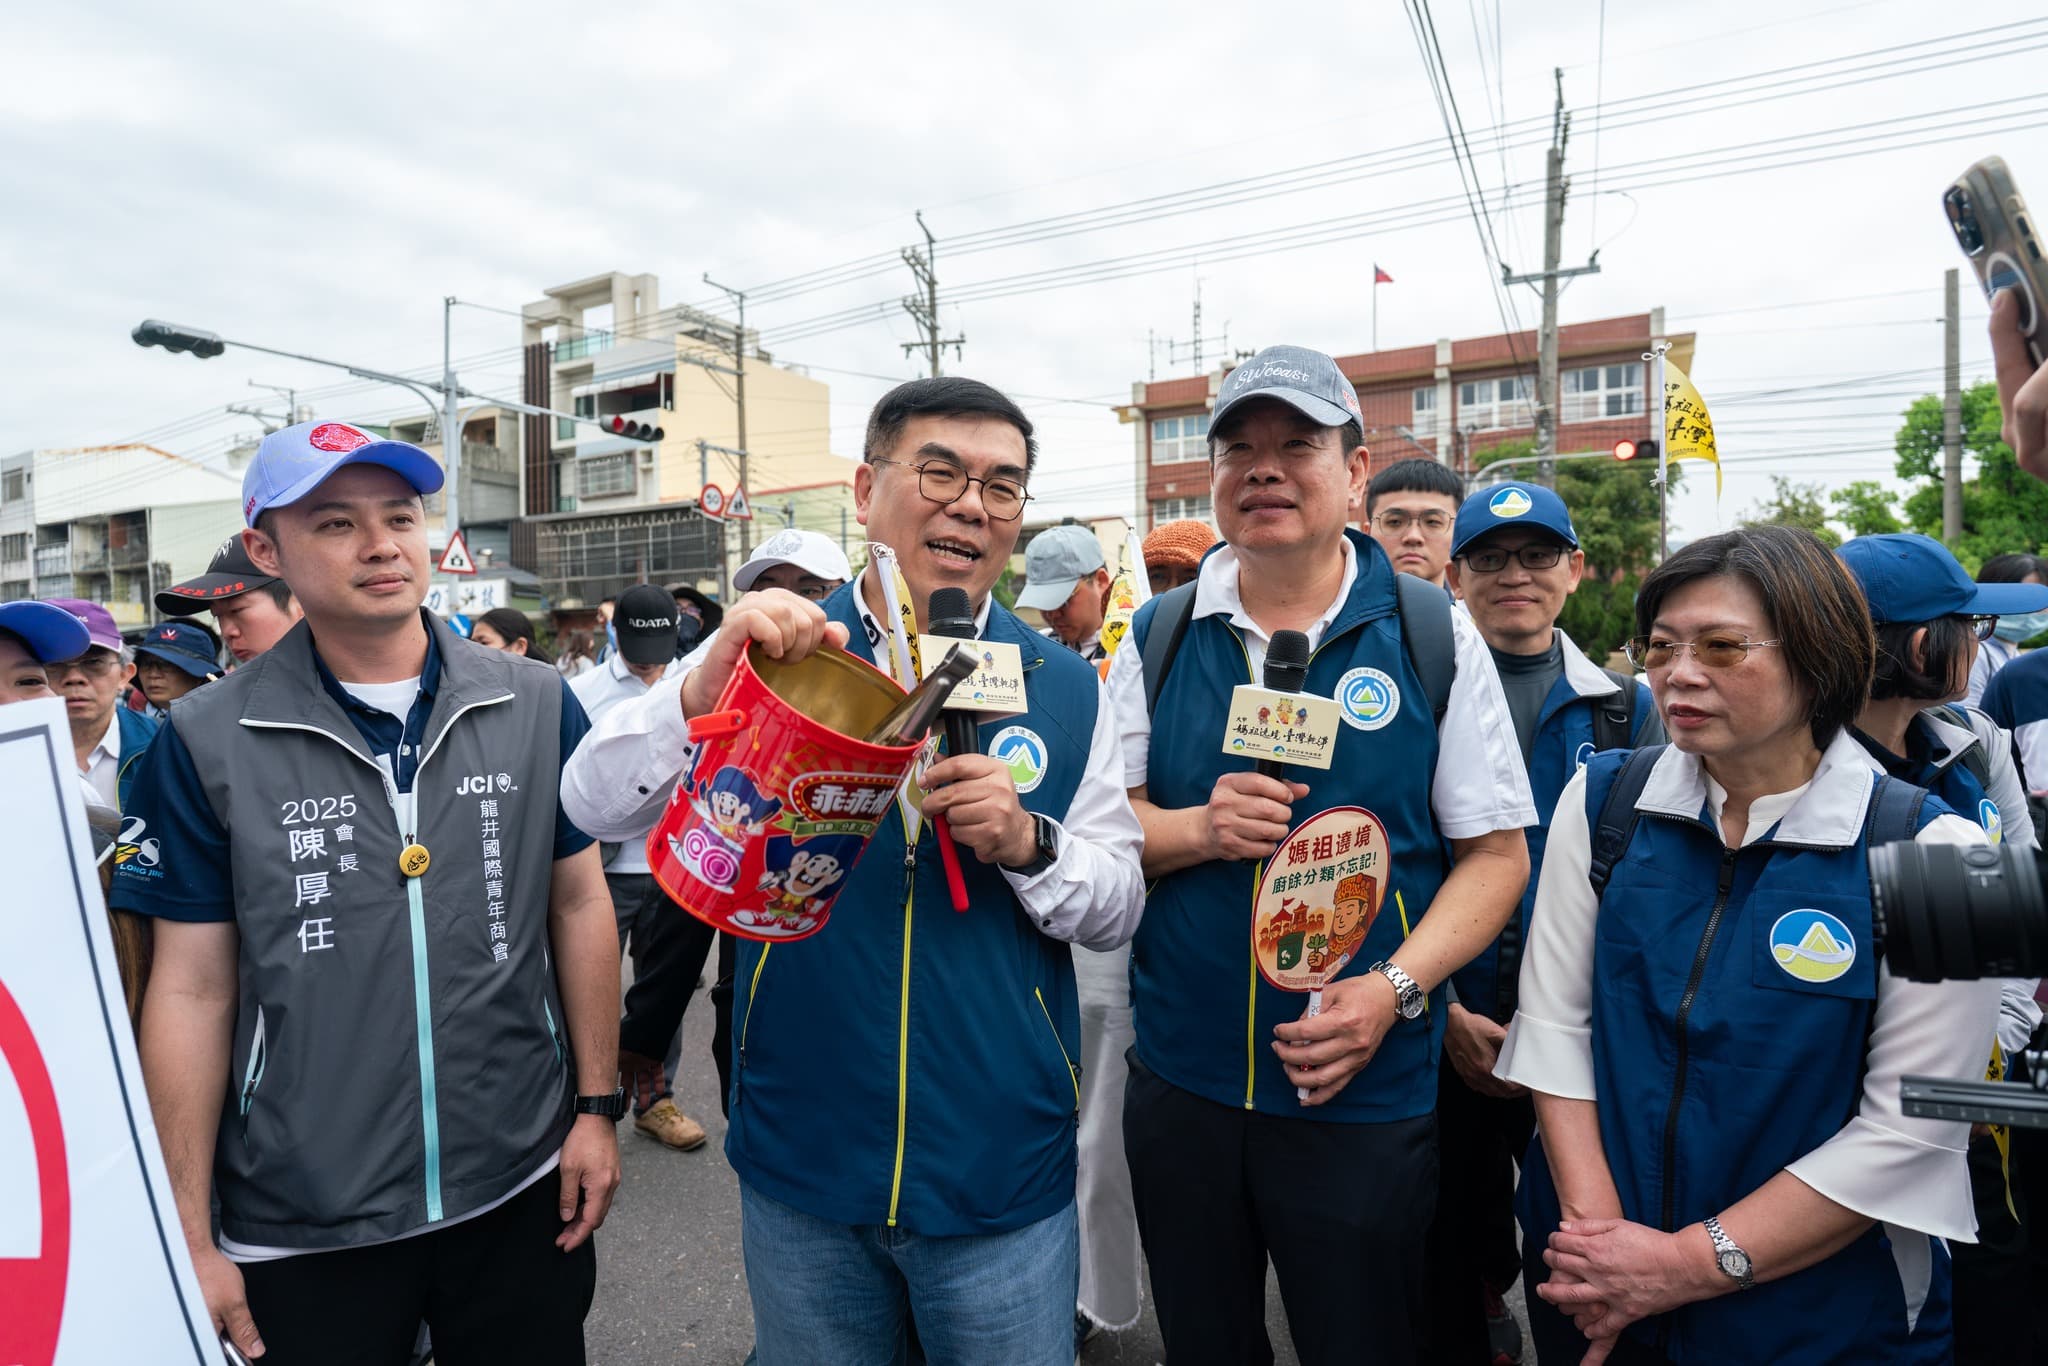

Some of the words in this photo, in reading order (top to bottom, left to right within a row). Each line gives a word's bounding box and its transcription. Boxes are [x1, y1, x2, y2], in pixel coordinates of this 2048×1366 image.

[628, 617, 671, 628] ADATA
[456, 774, 493, 796] JCI
[281, 794, 357, 826] 2025
[333, 823, 360, 873] 會長
[1287, 823, 1372, 868] 媽祖遶境
[120, 864, 147, 875] LONG
[480, 799, 509, 964] 龍井國際青年商會
[289, 827, 335, 953] 陳厚任
